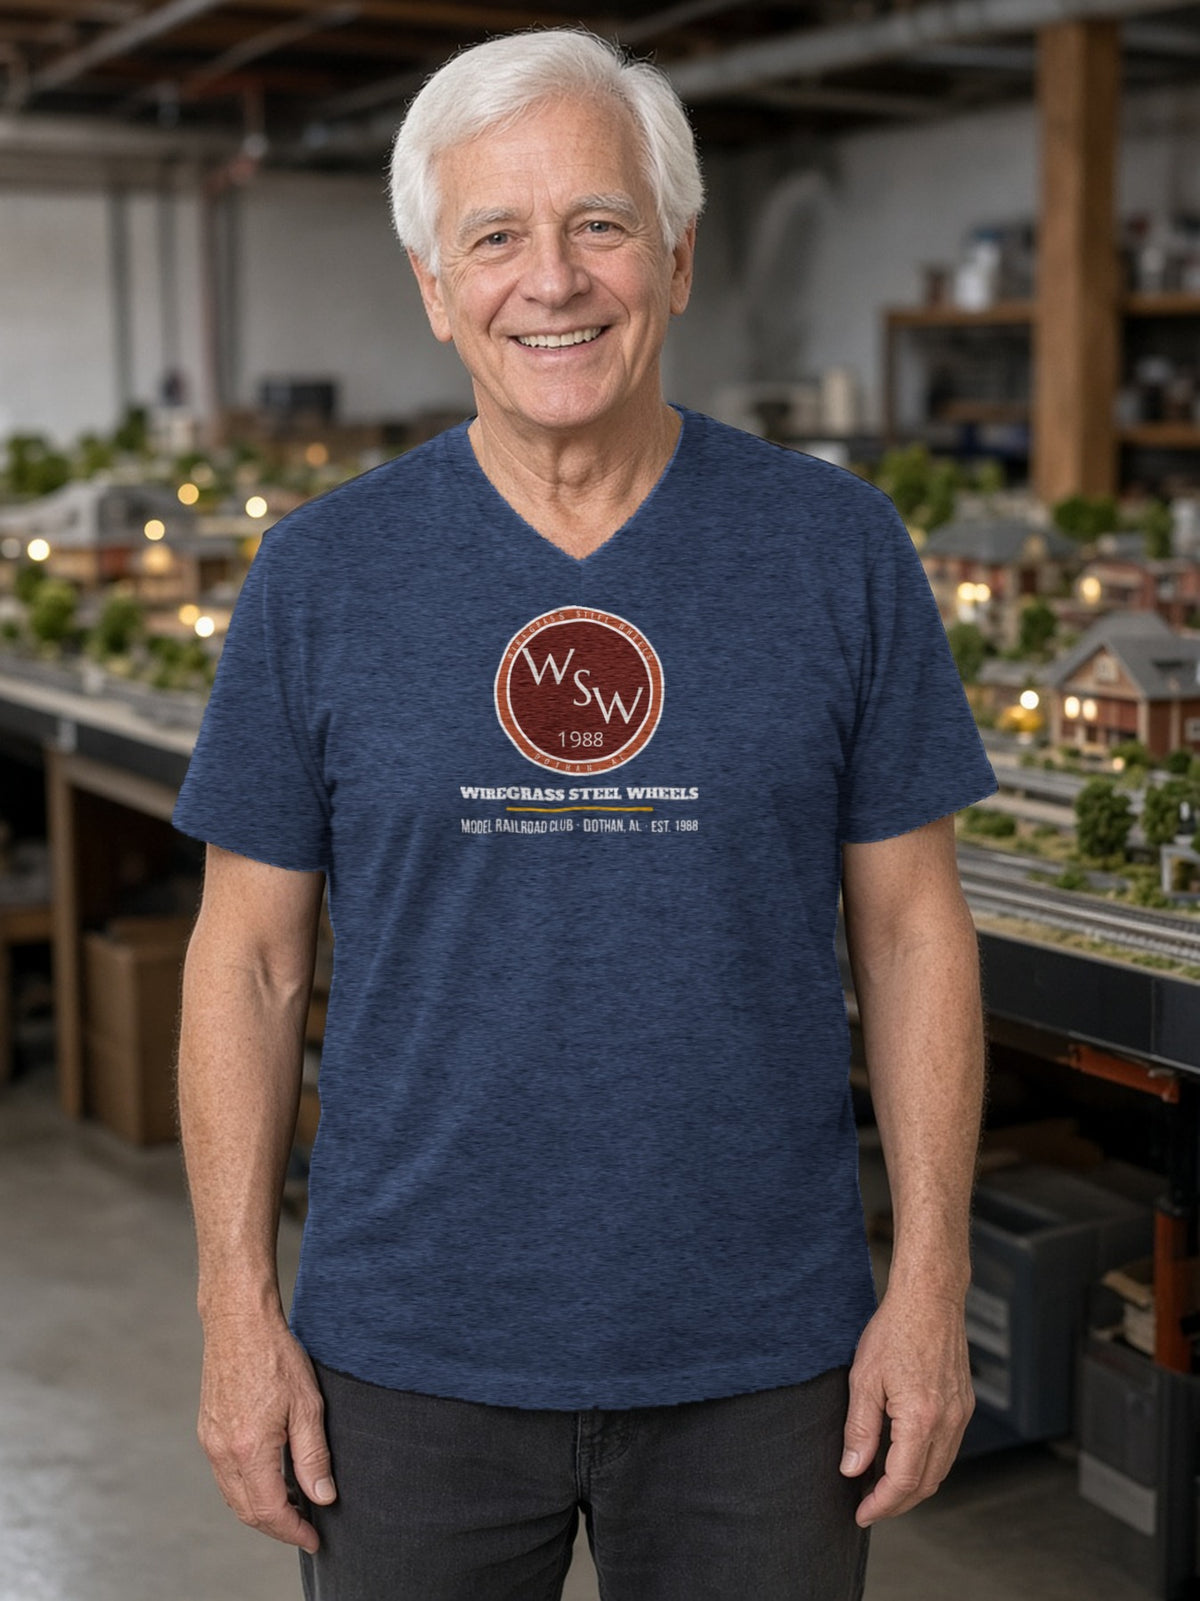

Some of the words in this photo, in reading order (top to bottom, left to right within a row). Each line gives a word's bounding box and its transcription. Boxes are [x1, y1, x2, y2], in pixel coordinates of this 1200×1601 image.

[558, 730, 604, 748] 1988
[460, 786, 565, 801] WIREGRASS
[568, 787, 622, 800] STEEL
[626, 787, 699, 800] WHEELS
[461, 818, 492, 834] MODEL
[495, 818, 548, 834] RAILROAD
[549, 818, 574, 832] CLUB
[583, 818, 627, 833] DOTHAN,
[628, 819, 643, 832] AL
[651, 820, 671, 833] EST.
[675, 819, 699, 832] 1988
